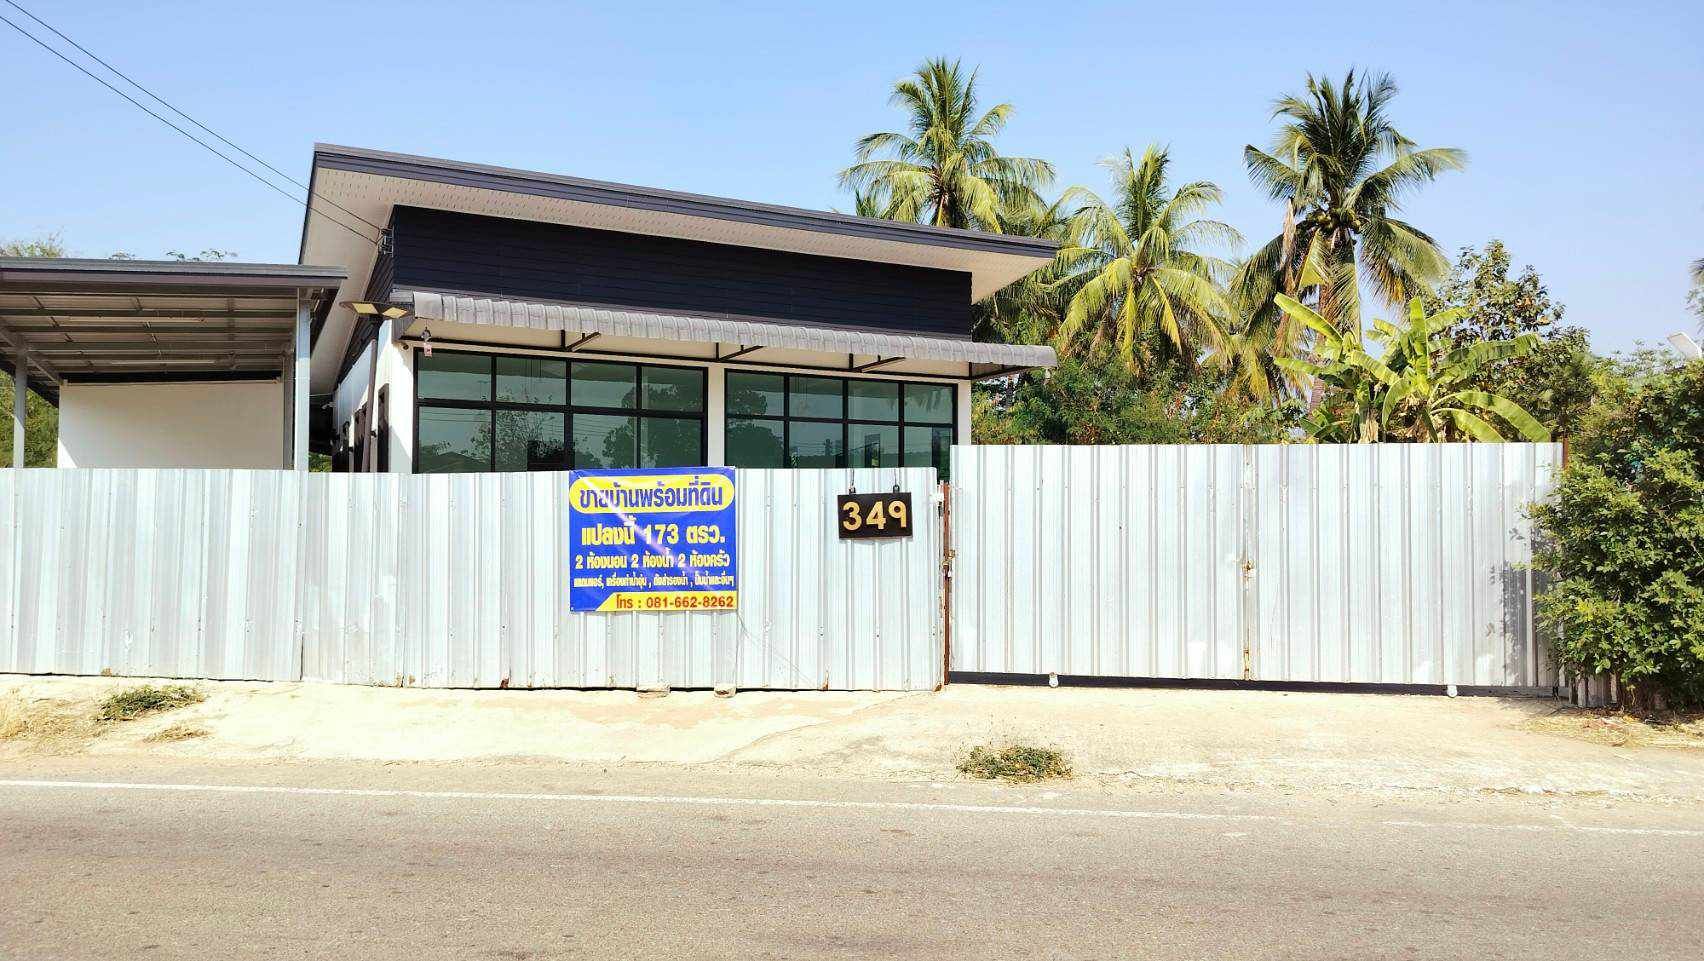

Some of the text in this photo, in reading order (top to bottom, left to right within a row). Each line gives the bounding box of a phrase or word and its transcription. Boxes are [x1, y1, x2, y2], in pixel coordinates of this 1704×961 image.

[580, 476, 722, 508] ขายบ้านพร้อมที่ดิน
[581, 514, 725, 545] แปลงนี้ 173 ตรว.
[843, 501, 906, 530] 349
[575, 547, 731, 569] 2 ห้องนอน 2 ห้องน้ำ 2 ห้องครัว
[616, 594, 633, 608] โทร
[646, 596, 734, 608] 081-662-8262
